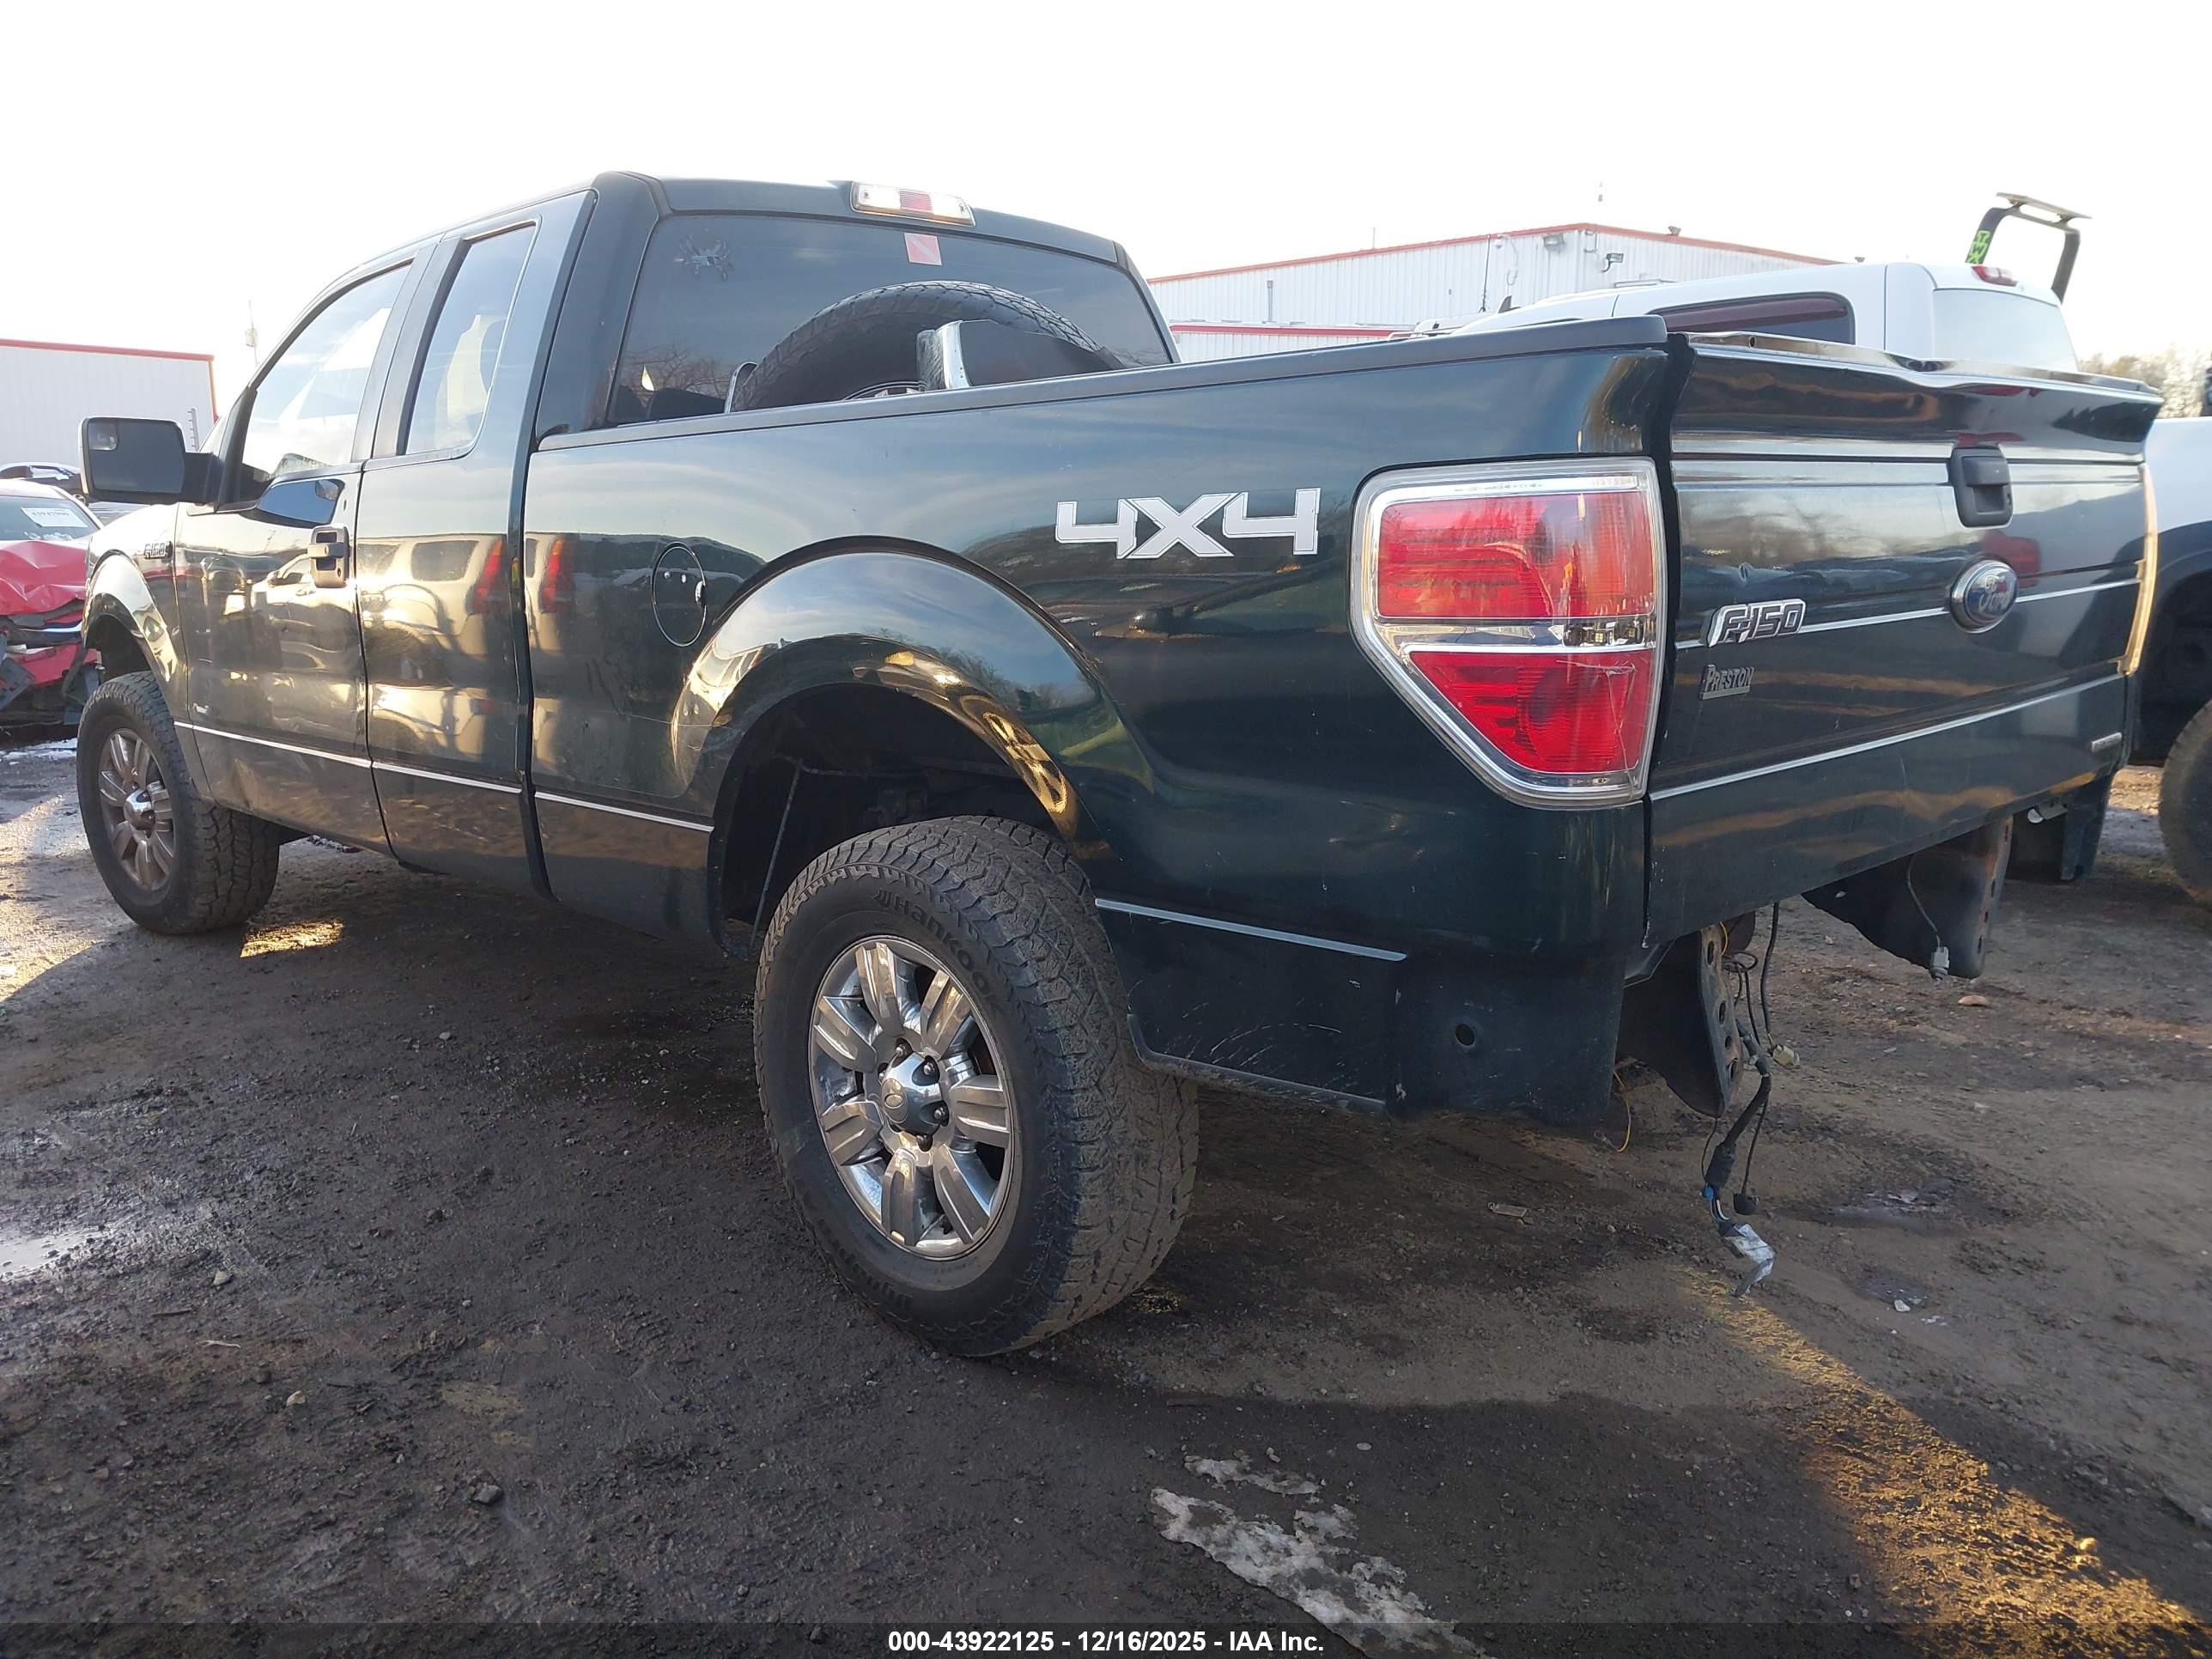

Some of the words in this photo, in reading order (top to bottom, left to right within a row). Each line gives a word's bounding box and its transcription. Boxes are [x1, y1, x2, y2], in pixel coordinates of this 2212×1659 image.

[1055, 488, 1321, 559] 4X4
[1711, 599, 1806, 646] F-150
[1978, 574, 2010, 613] Ford
[894, 894, 994, 1001] Hankoo
